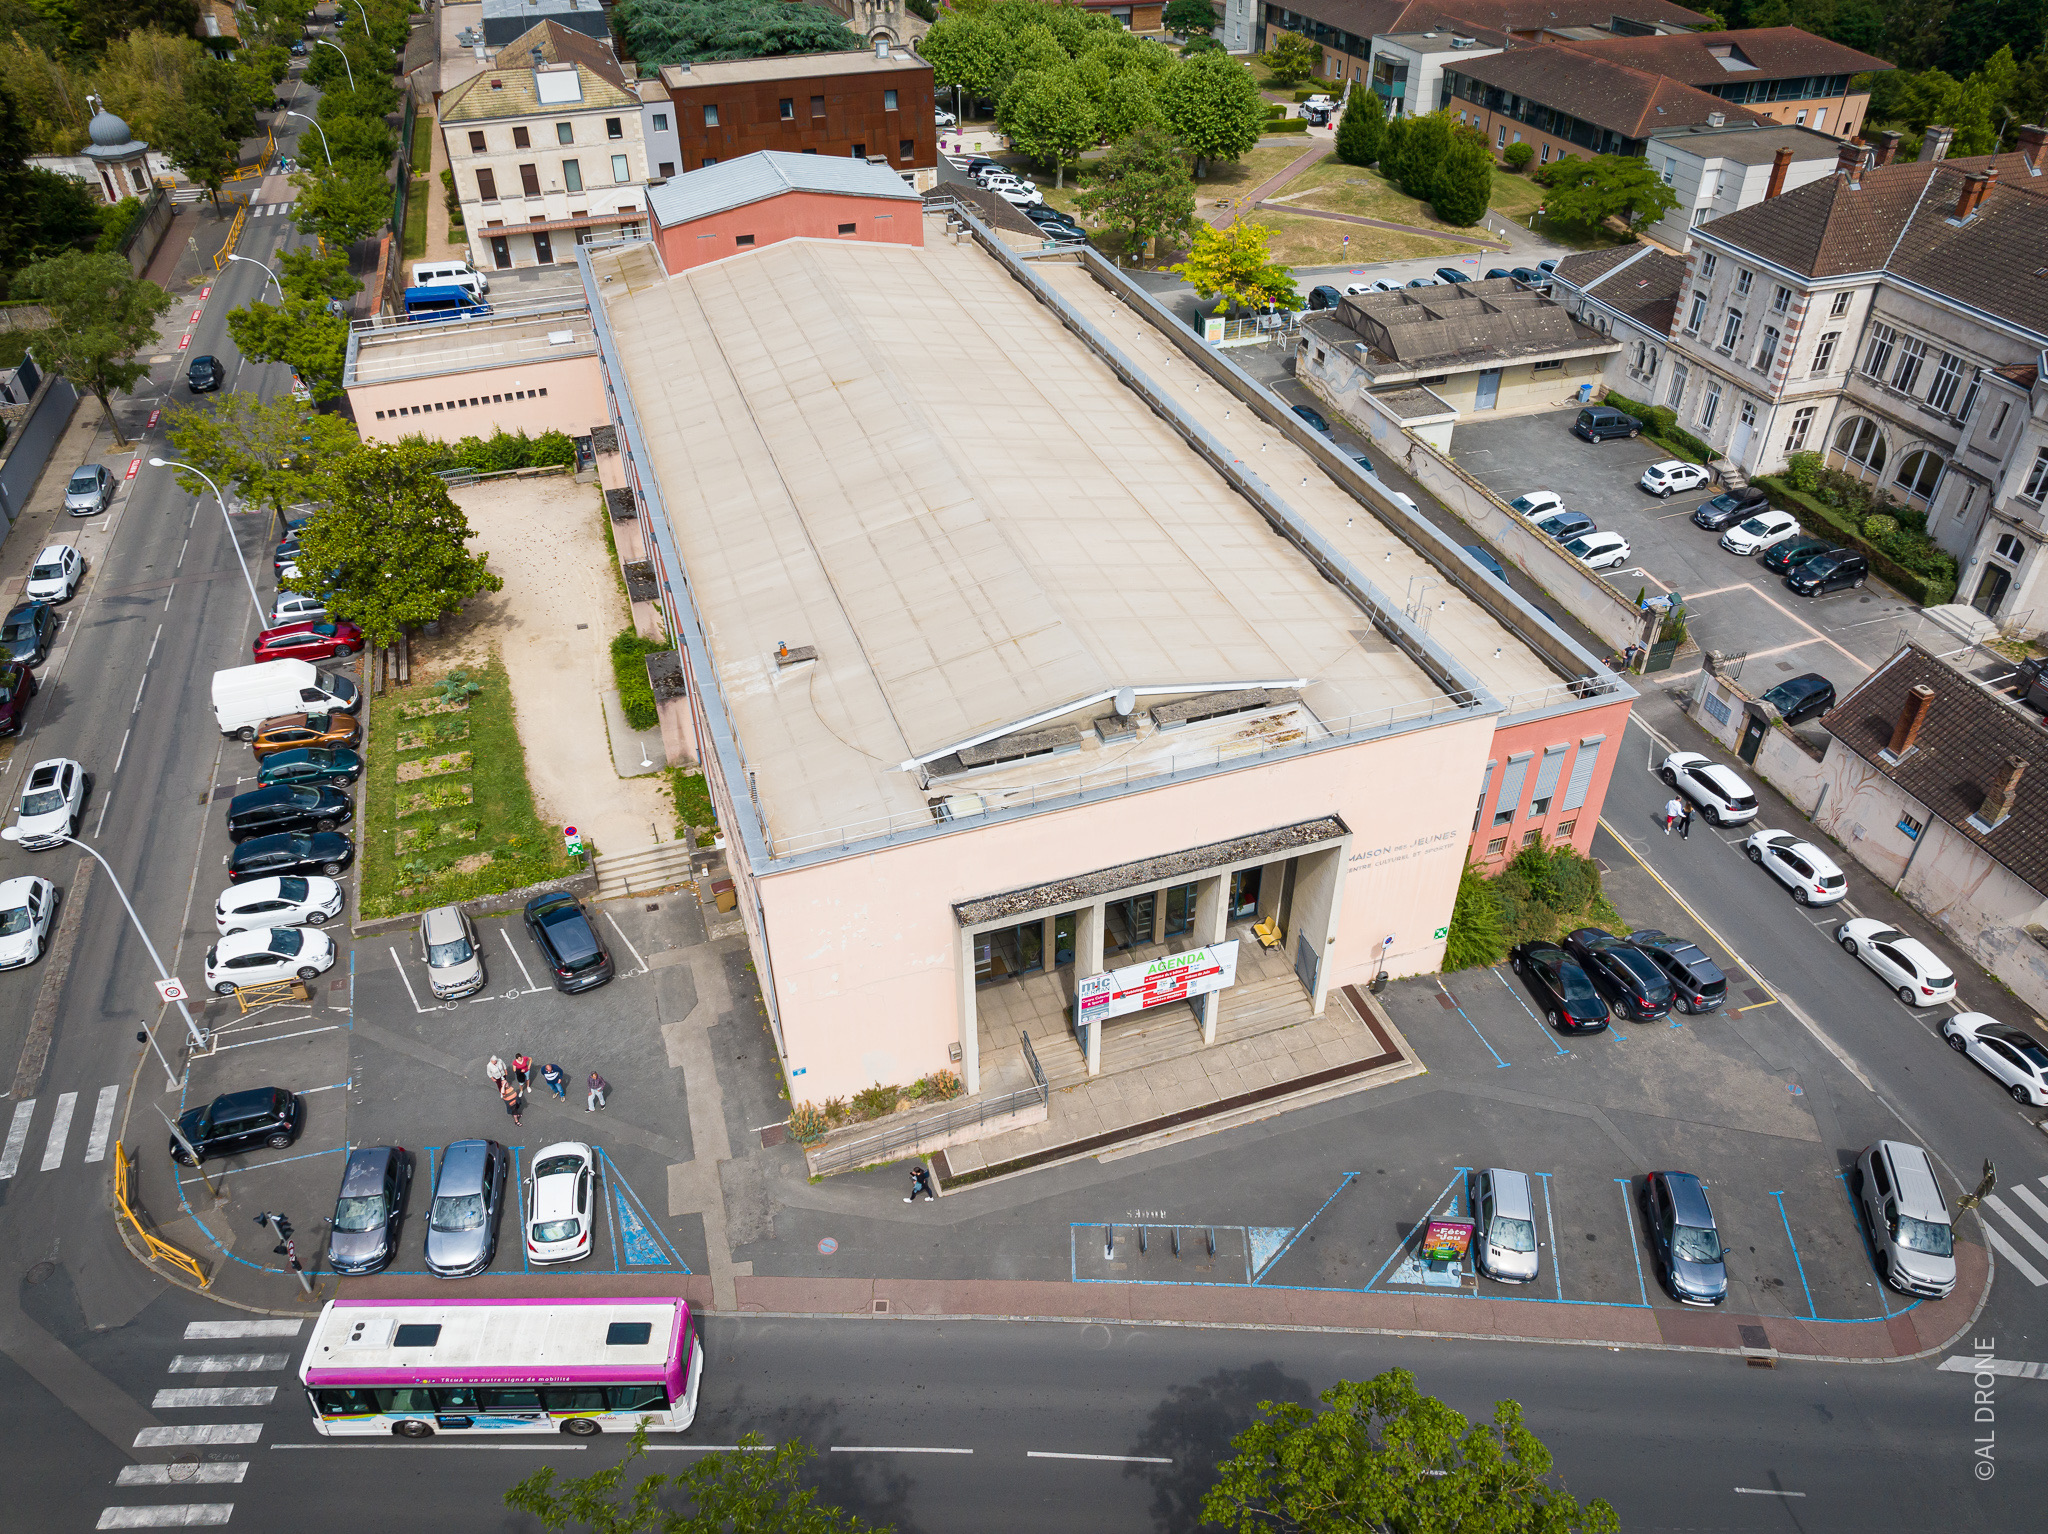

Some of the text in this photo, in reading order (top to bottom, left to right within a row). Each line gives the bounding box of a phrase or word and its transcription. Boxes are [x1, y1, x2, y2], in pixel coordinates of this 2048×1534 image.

[1348, 830, 1457, 862] MAISON DES JEUNES
[1375, 854, 1410, 867] CULTUREL
[1424, 843, 1455, 855] SPORTIF
[1148, 952, 1205, 975] AGENDA
[1440, 1227, 1467, 1236] Fête
[1440, 1232, 1461, 1241] Jeu
[504, 1376, 524, 1384] signe
